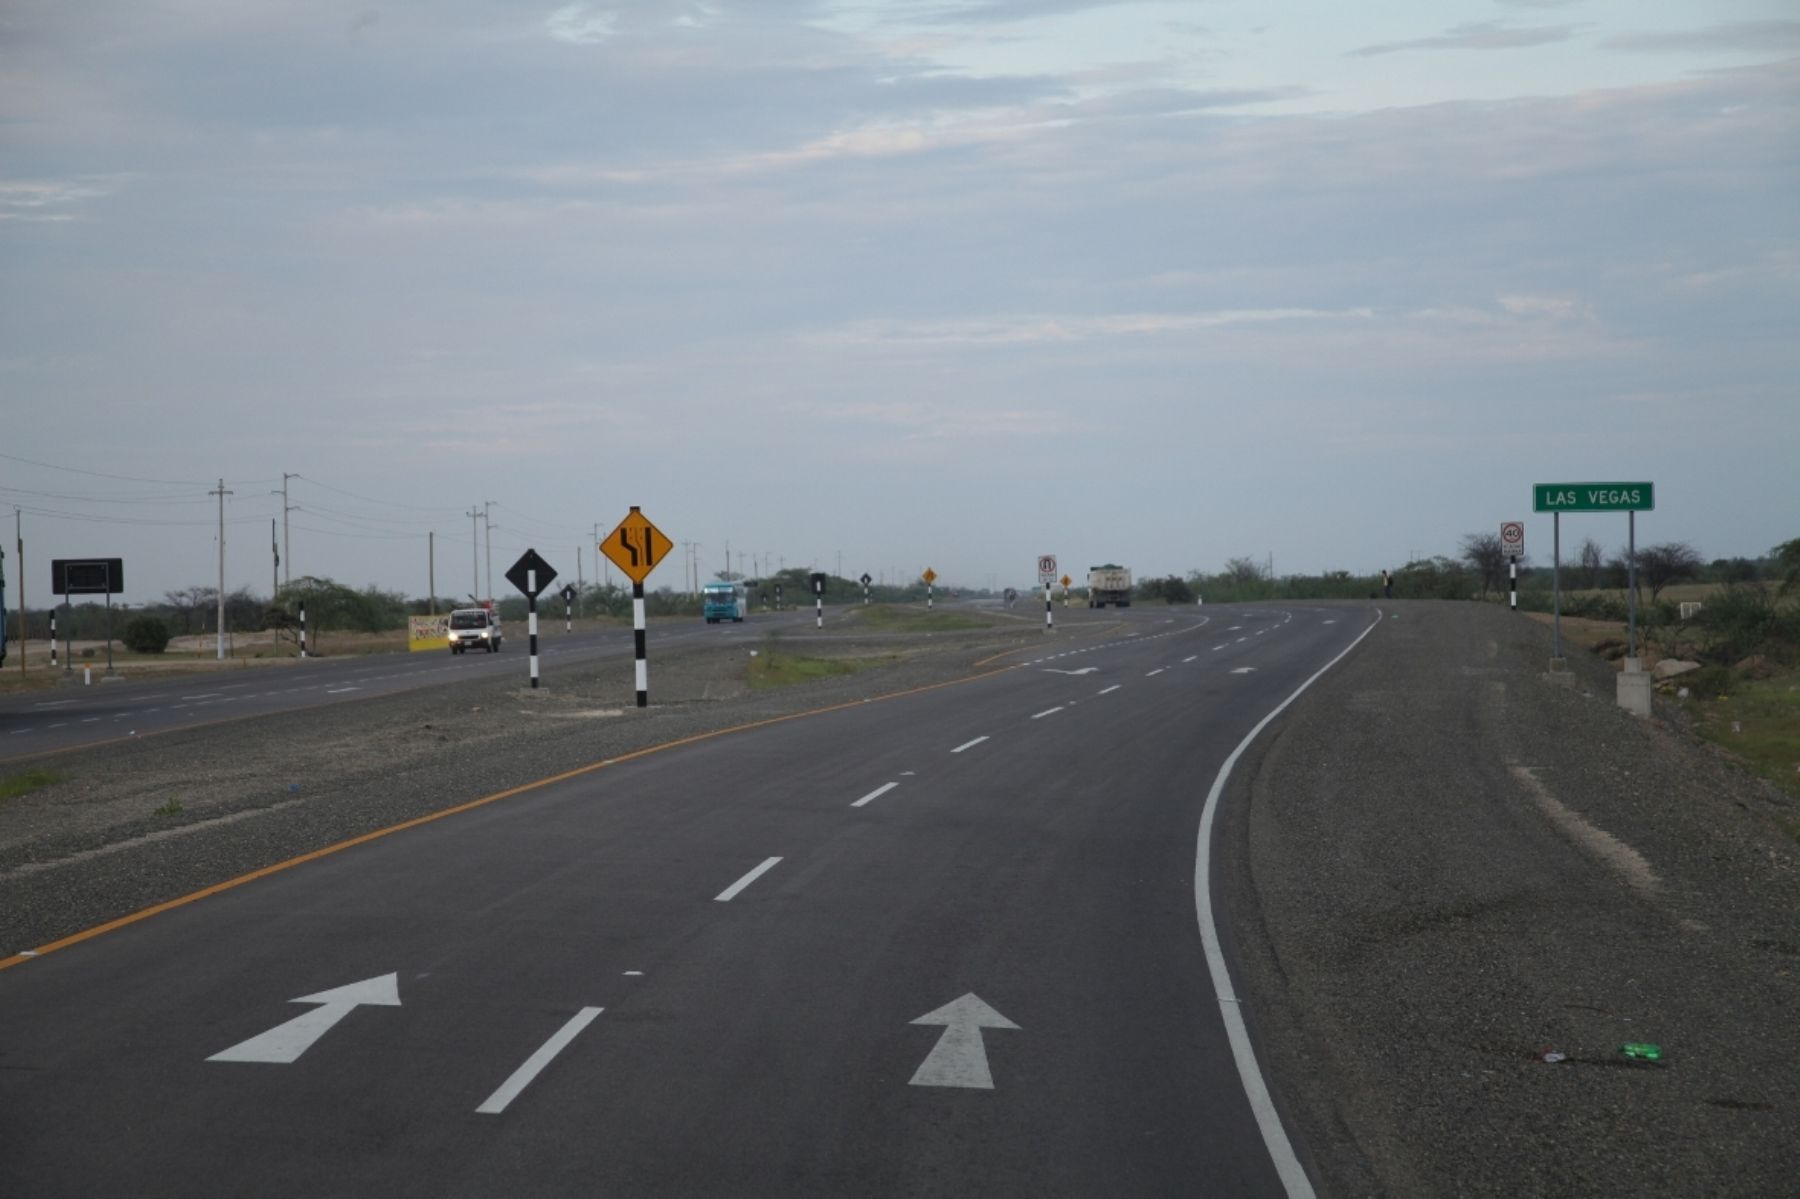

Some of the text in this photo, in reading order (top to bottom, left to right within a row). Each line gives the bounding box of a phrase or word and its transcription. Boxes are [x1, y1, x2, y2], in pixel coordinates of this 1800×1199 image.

[1545, 489, 1641, 506] LAS VEGAS
[1504, 529, 1520, 538] 40
